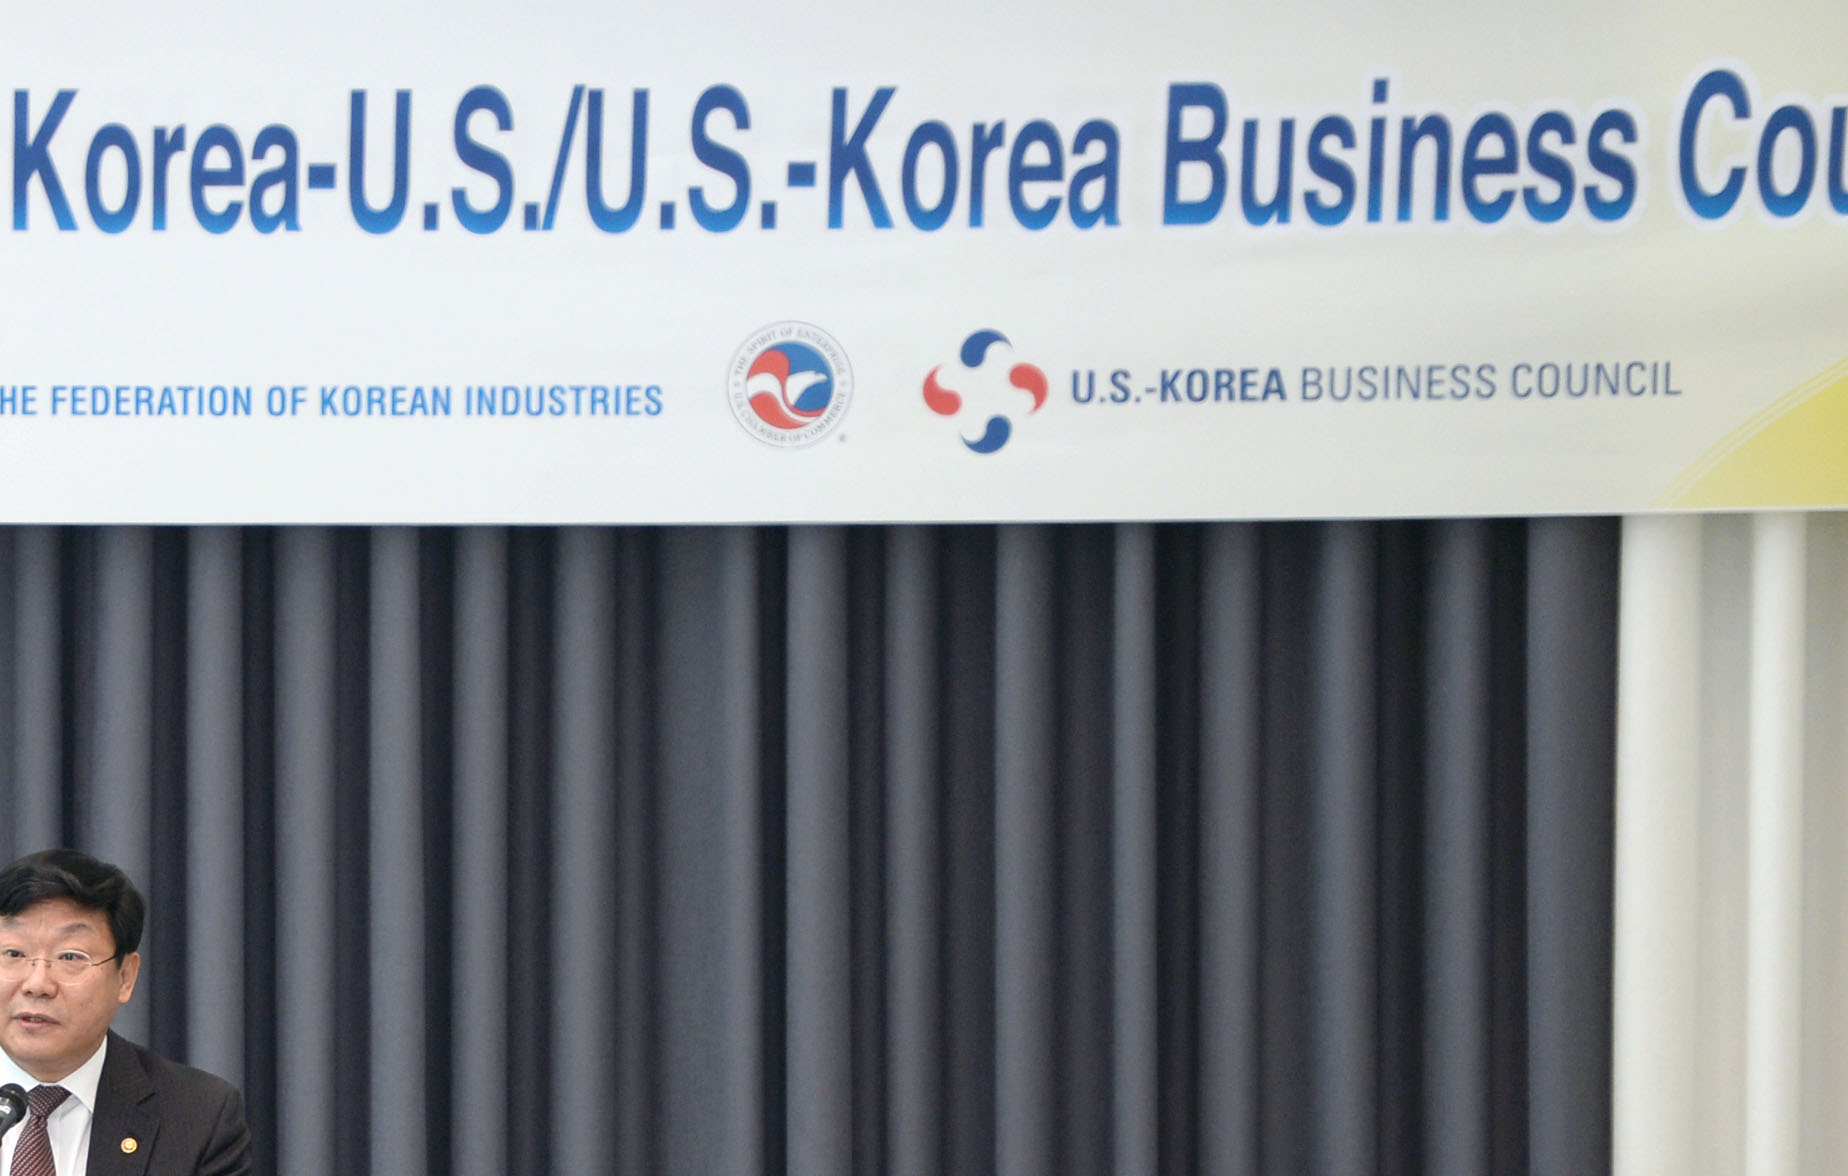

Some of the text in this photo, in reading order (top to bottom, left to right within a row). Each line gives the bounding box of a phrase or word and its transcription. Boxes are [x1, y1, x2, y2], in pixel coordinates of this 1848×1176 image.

[11, 83, 1122, 236] Korea-U.S./U.S.-Korea
[1160, 78, 1639, 228] Business
[49, 384, 253, 419] FEDERATION
[265, 384, 309, 418] OF
[319, 384, 453, 419] KOREAN
[464, 384, 664, 419] INDUSTRIES
[1069, 360, 1683, 406] U.S.-KOREA BUSINESS COUNCIL
